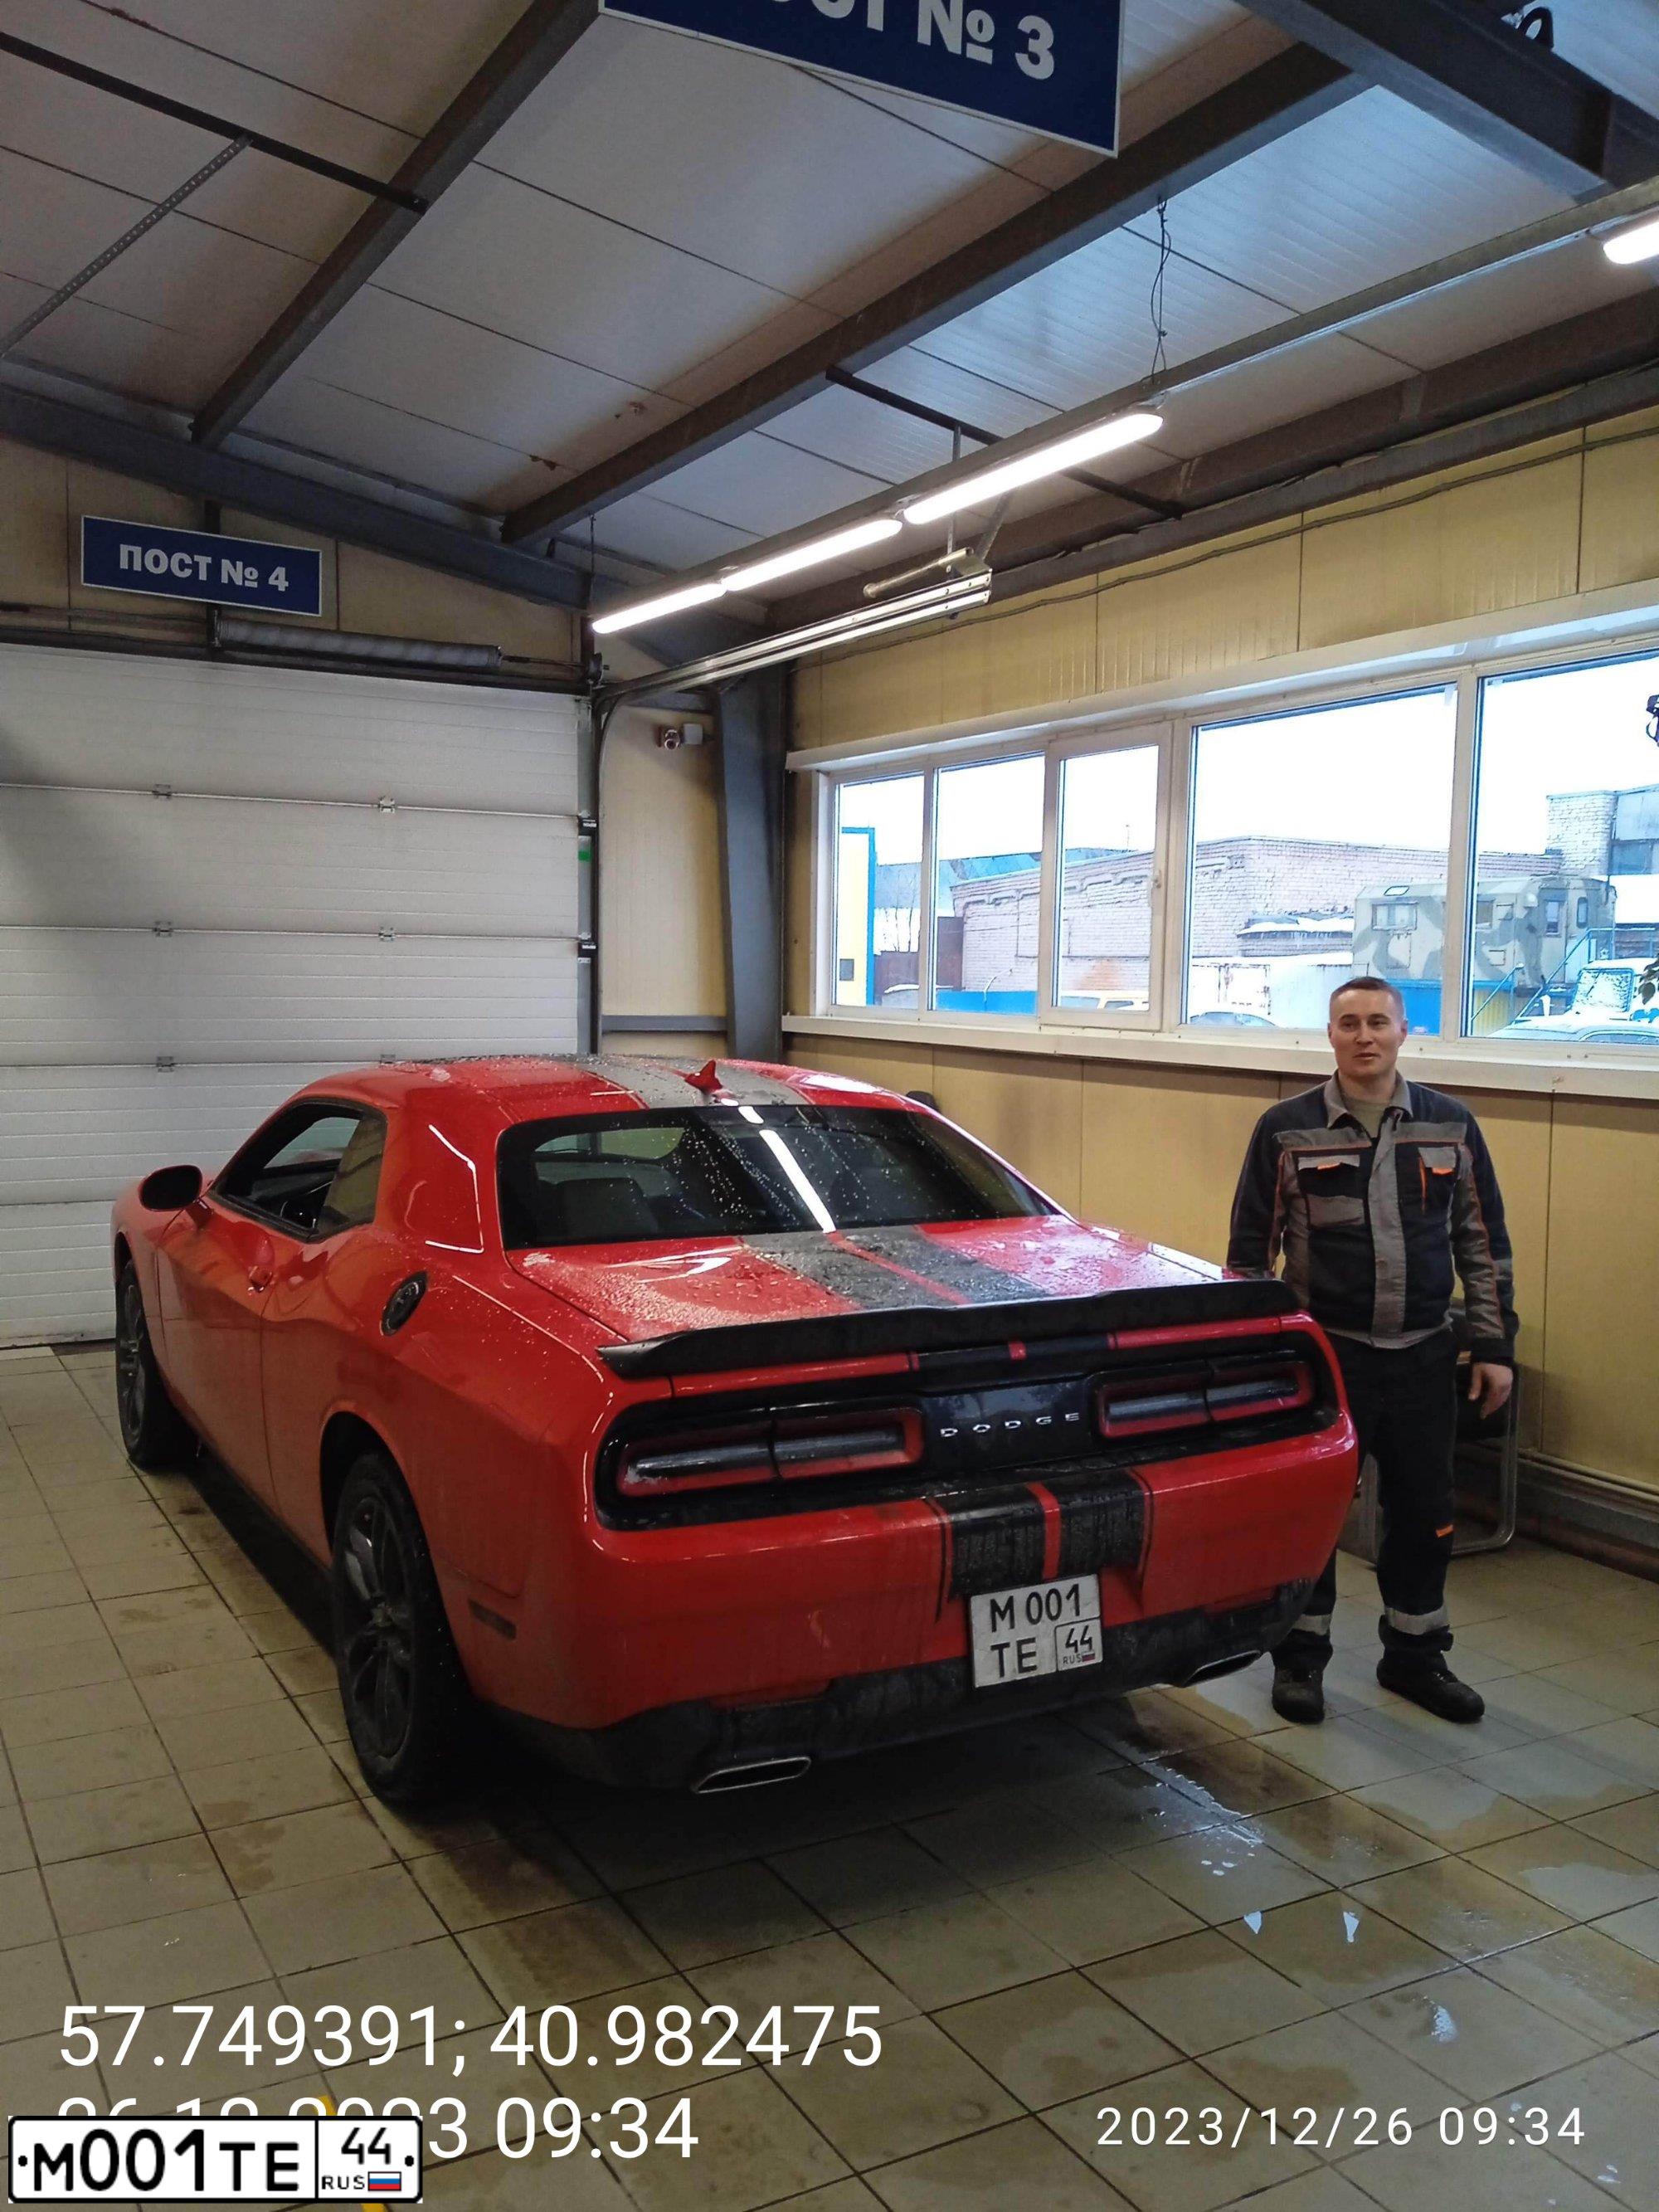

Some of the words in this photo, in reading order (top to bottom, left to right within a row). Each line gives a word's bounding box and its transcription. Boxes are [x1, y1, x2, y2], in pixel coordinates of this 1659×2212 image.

[917, 0, 995, 65] №
[1014, 15, 1054, 80] 3
[119, 543, 212, 581] ПОСТ
[221, 558, 259, 588] №
[268, 566, 289, 592] 4
[940, 1412, 1080, 1437] DODGE
[1065, 1625, 1093, 1654] 44
[1063, 1653, 1083, 1665] RUS
